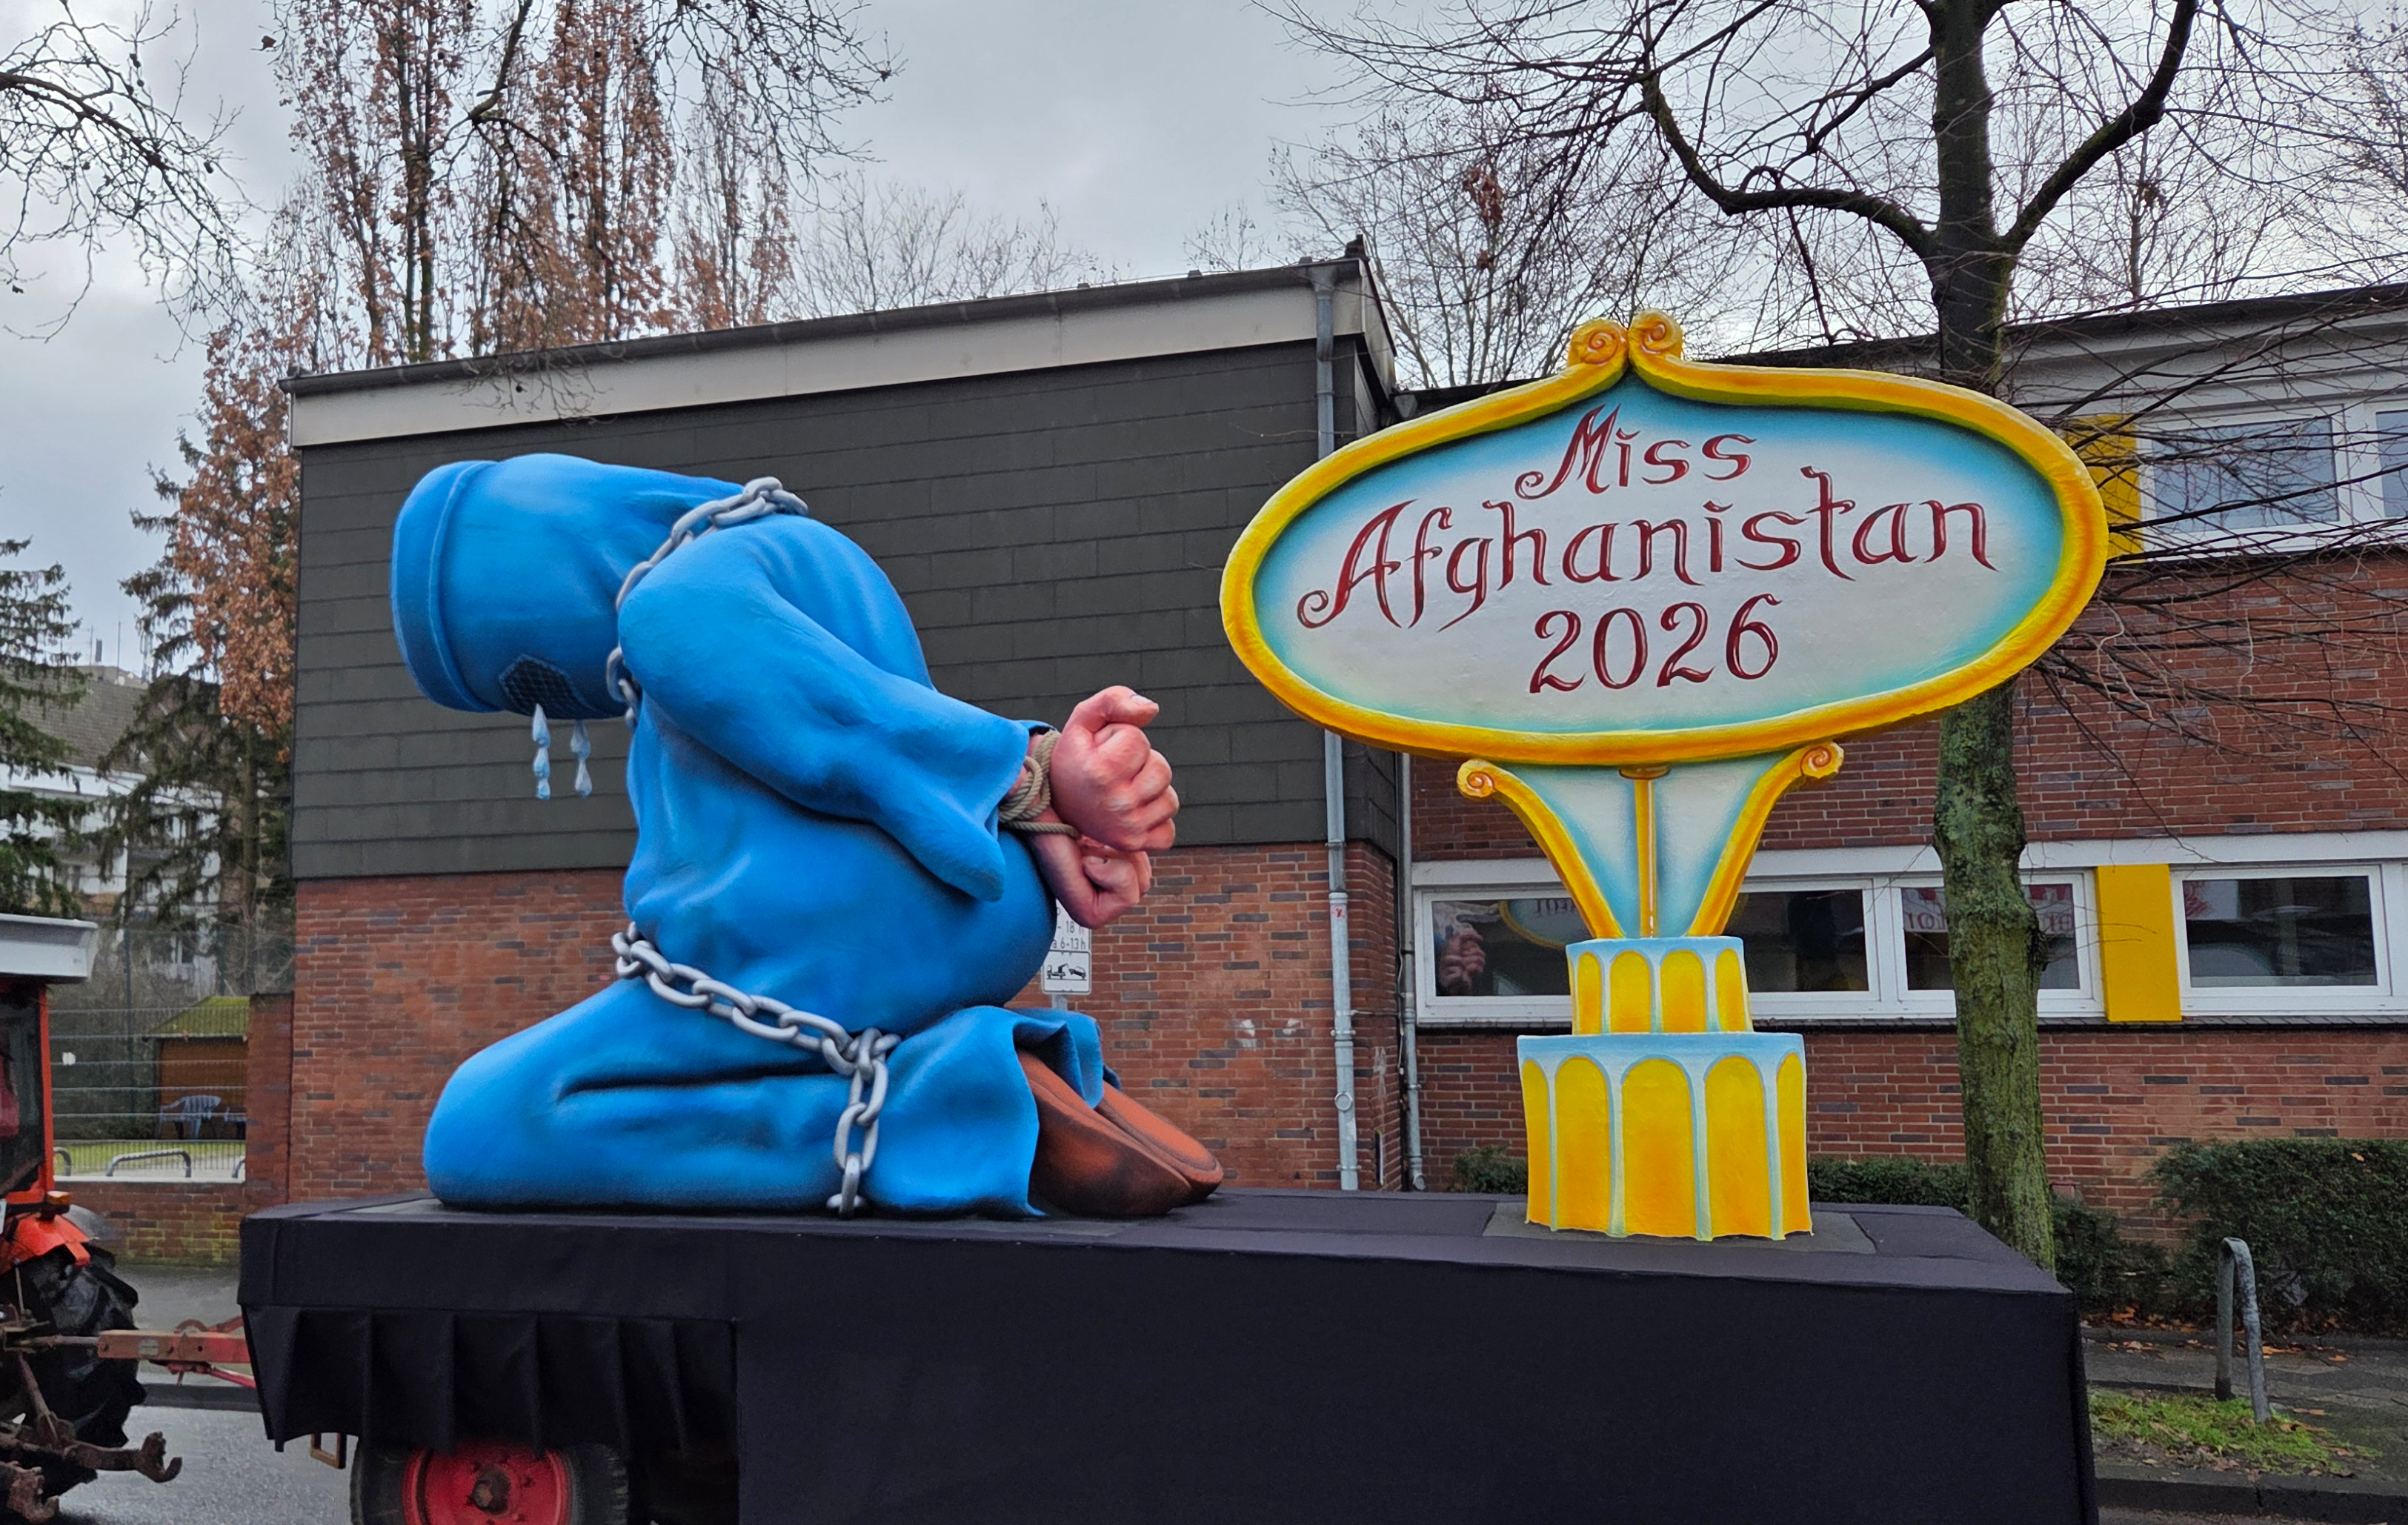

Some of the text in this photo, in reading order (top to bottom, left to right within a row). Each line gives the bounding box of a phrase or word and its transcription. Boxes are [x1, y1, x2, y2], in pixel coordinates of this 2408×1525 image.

[1514, 404, 1757, 500] Miss
[1297, 466, 1998, 631] Afghanistan
[1529, 593, 1781, 694] 2026
[1066, 920, 1075, 934] 18
[1080, 937, 1085, 950] h
